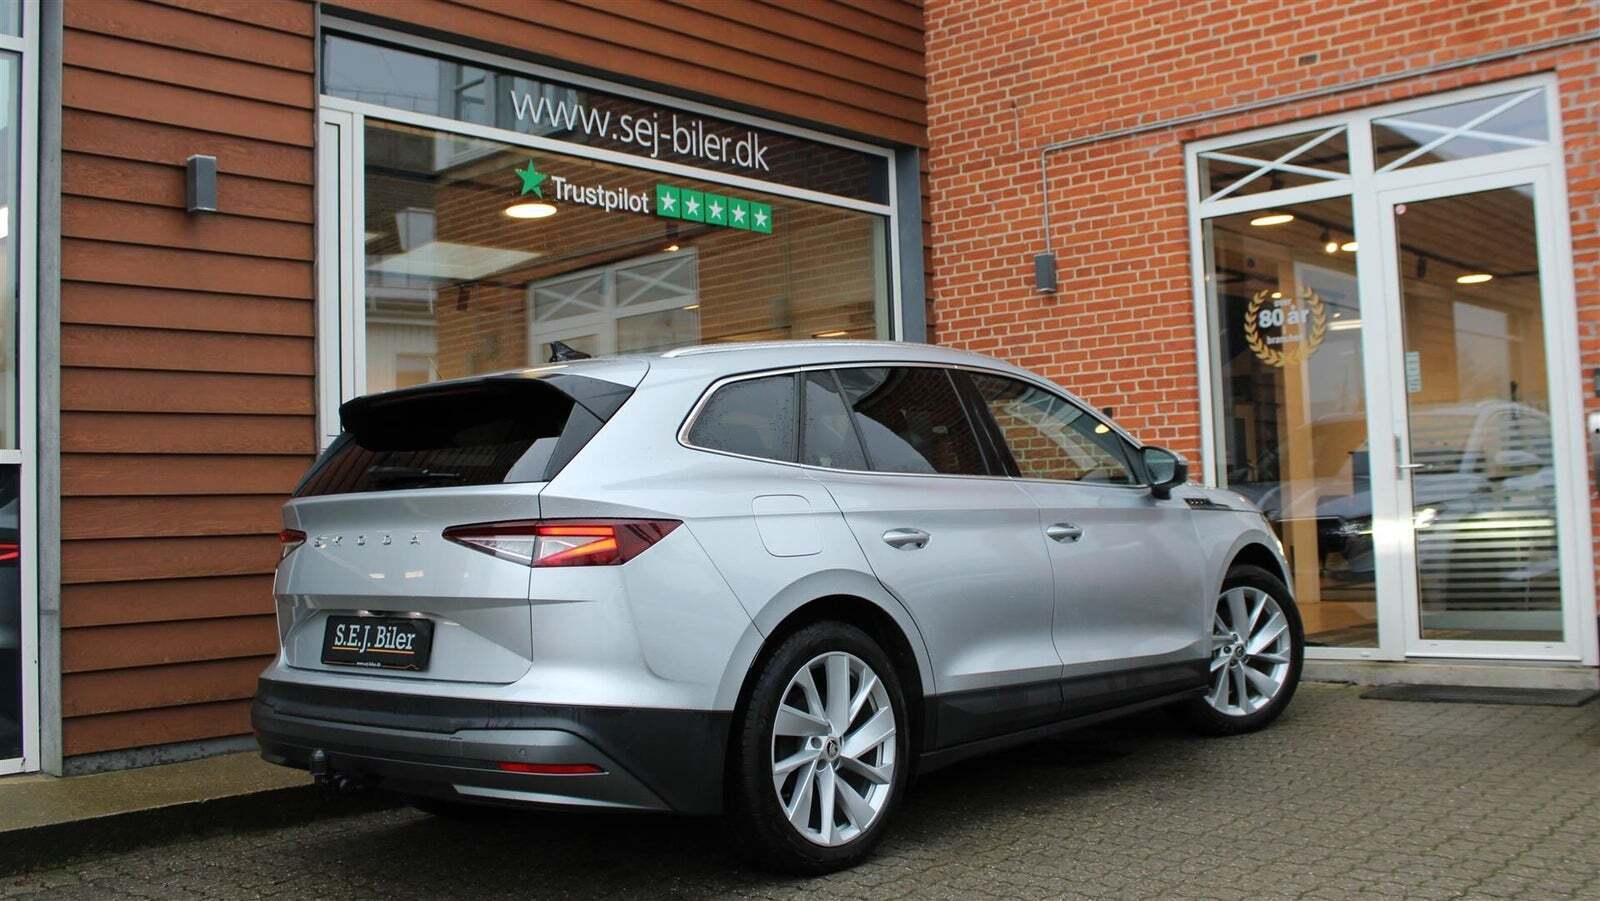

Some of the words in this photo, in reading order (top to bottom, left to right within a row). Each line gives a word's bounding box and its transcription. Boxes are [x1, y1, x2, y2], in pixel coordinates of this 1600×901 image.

[510, 90, 769, 171] www.sej-biler.dk
[551, 175, 649, 214] Trustpilot
[1259, 309, 1284, 328] 80
[334, 623, 371, 653] S.E.J.
[374, 625, 416, 650] Biler
